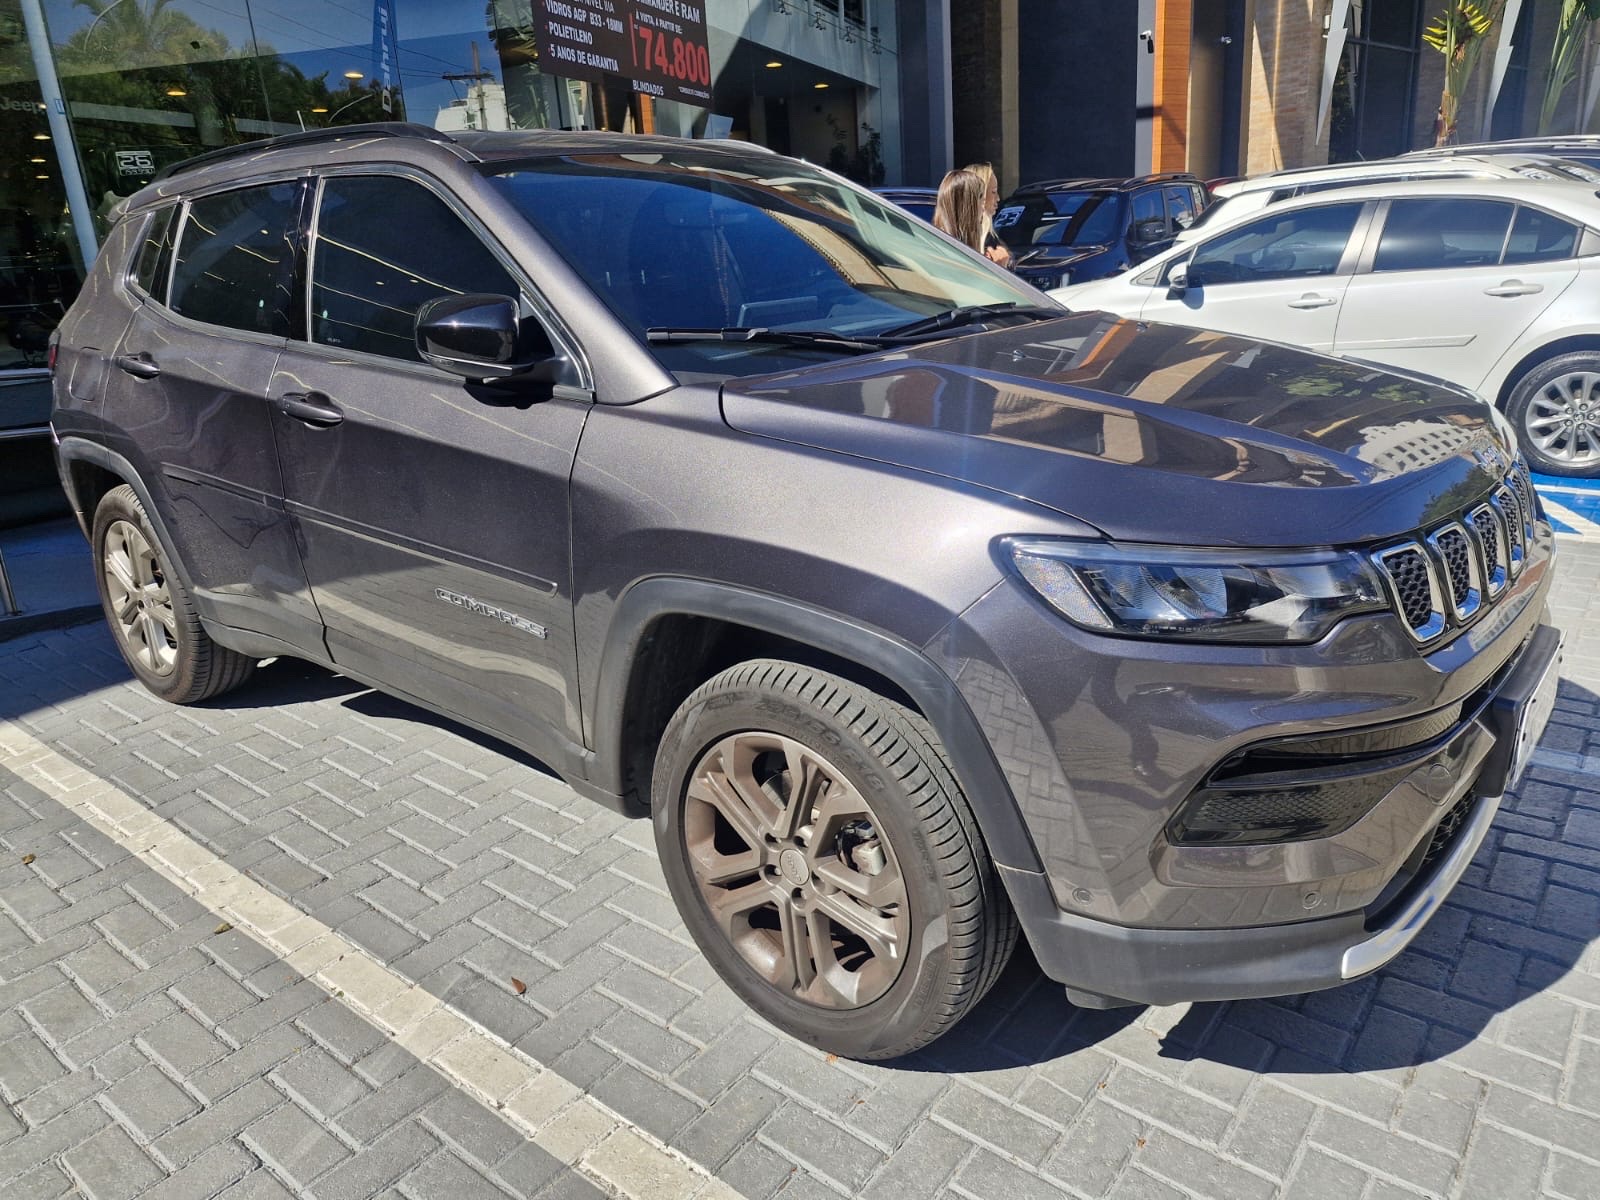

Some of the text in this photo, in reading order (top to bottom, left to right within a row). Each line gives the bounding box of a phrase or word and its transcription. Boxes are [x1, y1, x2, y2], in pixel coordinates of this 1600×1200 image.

[545, 0, 572, 18] VIDROS
[573, 7, 587, 22] AGP
[589, 12, 602, 27] B33
[675, 1, 680, 16] E
[681, 2, 701, 23] RAM
[548, 21, 593, 45] POLIETILENO
[550, 43, 619, 72] 5 ANOS DE GARANTIA
[639, 26, 709, 86] 74.800
[632, 79, 664, 96] BLINDADOS
